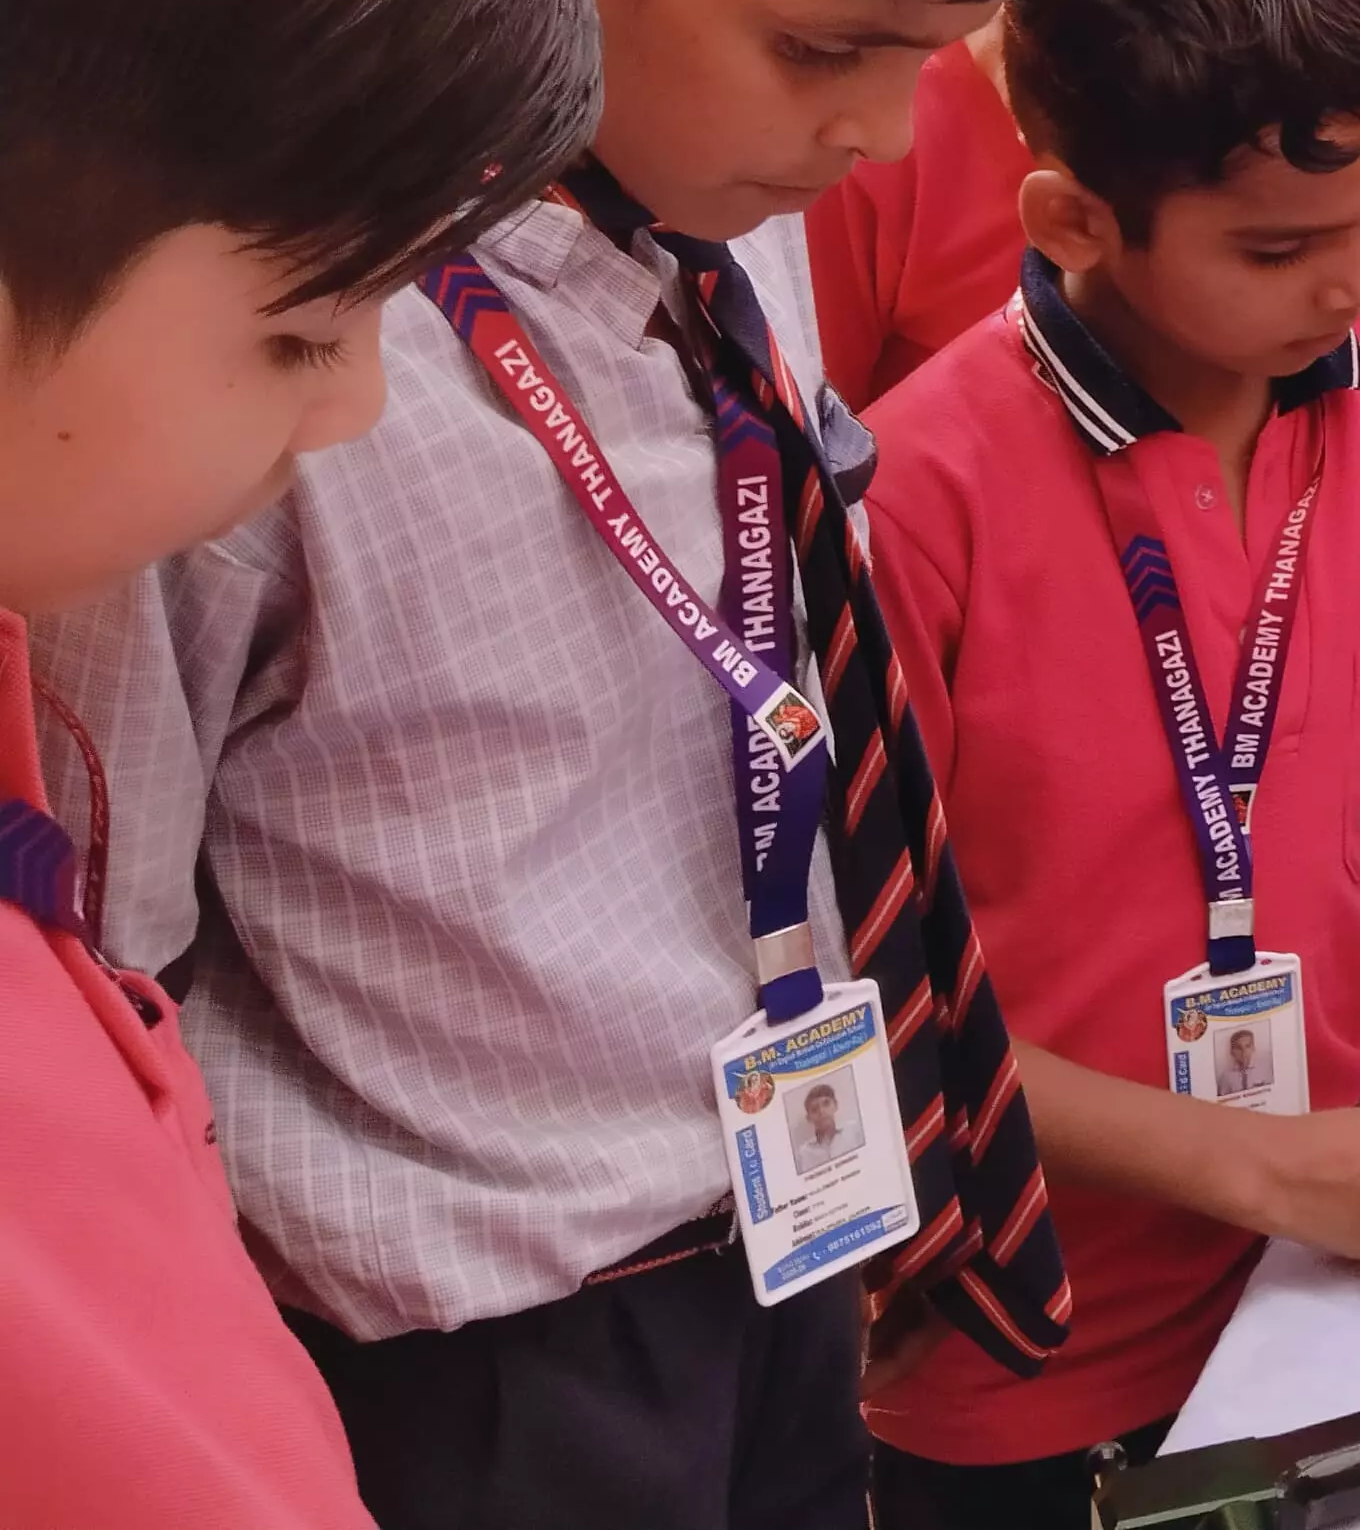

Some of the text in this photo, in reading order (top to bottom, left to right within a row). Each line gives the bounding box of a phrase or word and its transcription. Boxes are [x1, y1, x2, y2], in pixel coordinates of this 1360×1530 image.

[494, 338, 758, 688] BM ACADEMY THANAGAZI
[1155, 630, 1210, 769] THANAGAZI
[1239, 608, 1285, 727] ACADEMY
[1230, 732, 1261, 769] BM
[757, 821, 778, 872] M
[1191, 767, 1242, 890] ACADEMY
[1218, 976, 1286, 1001] ACADEMY
[743, 1049, 782, 1072] B.M.
[785, 1007, 868, 1048] ACADEMY
